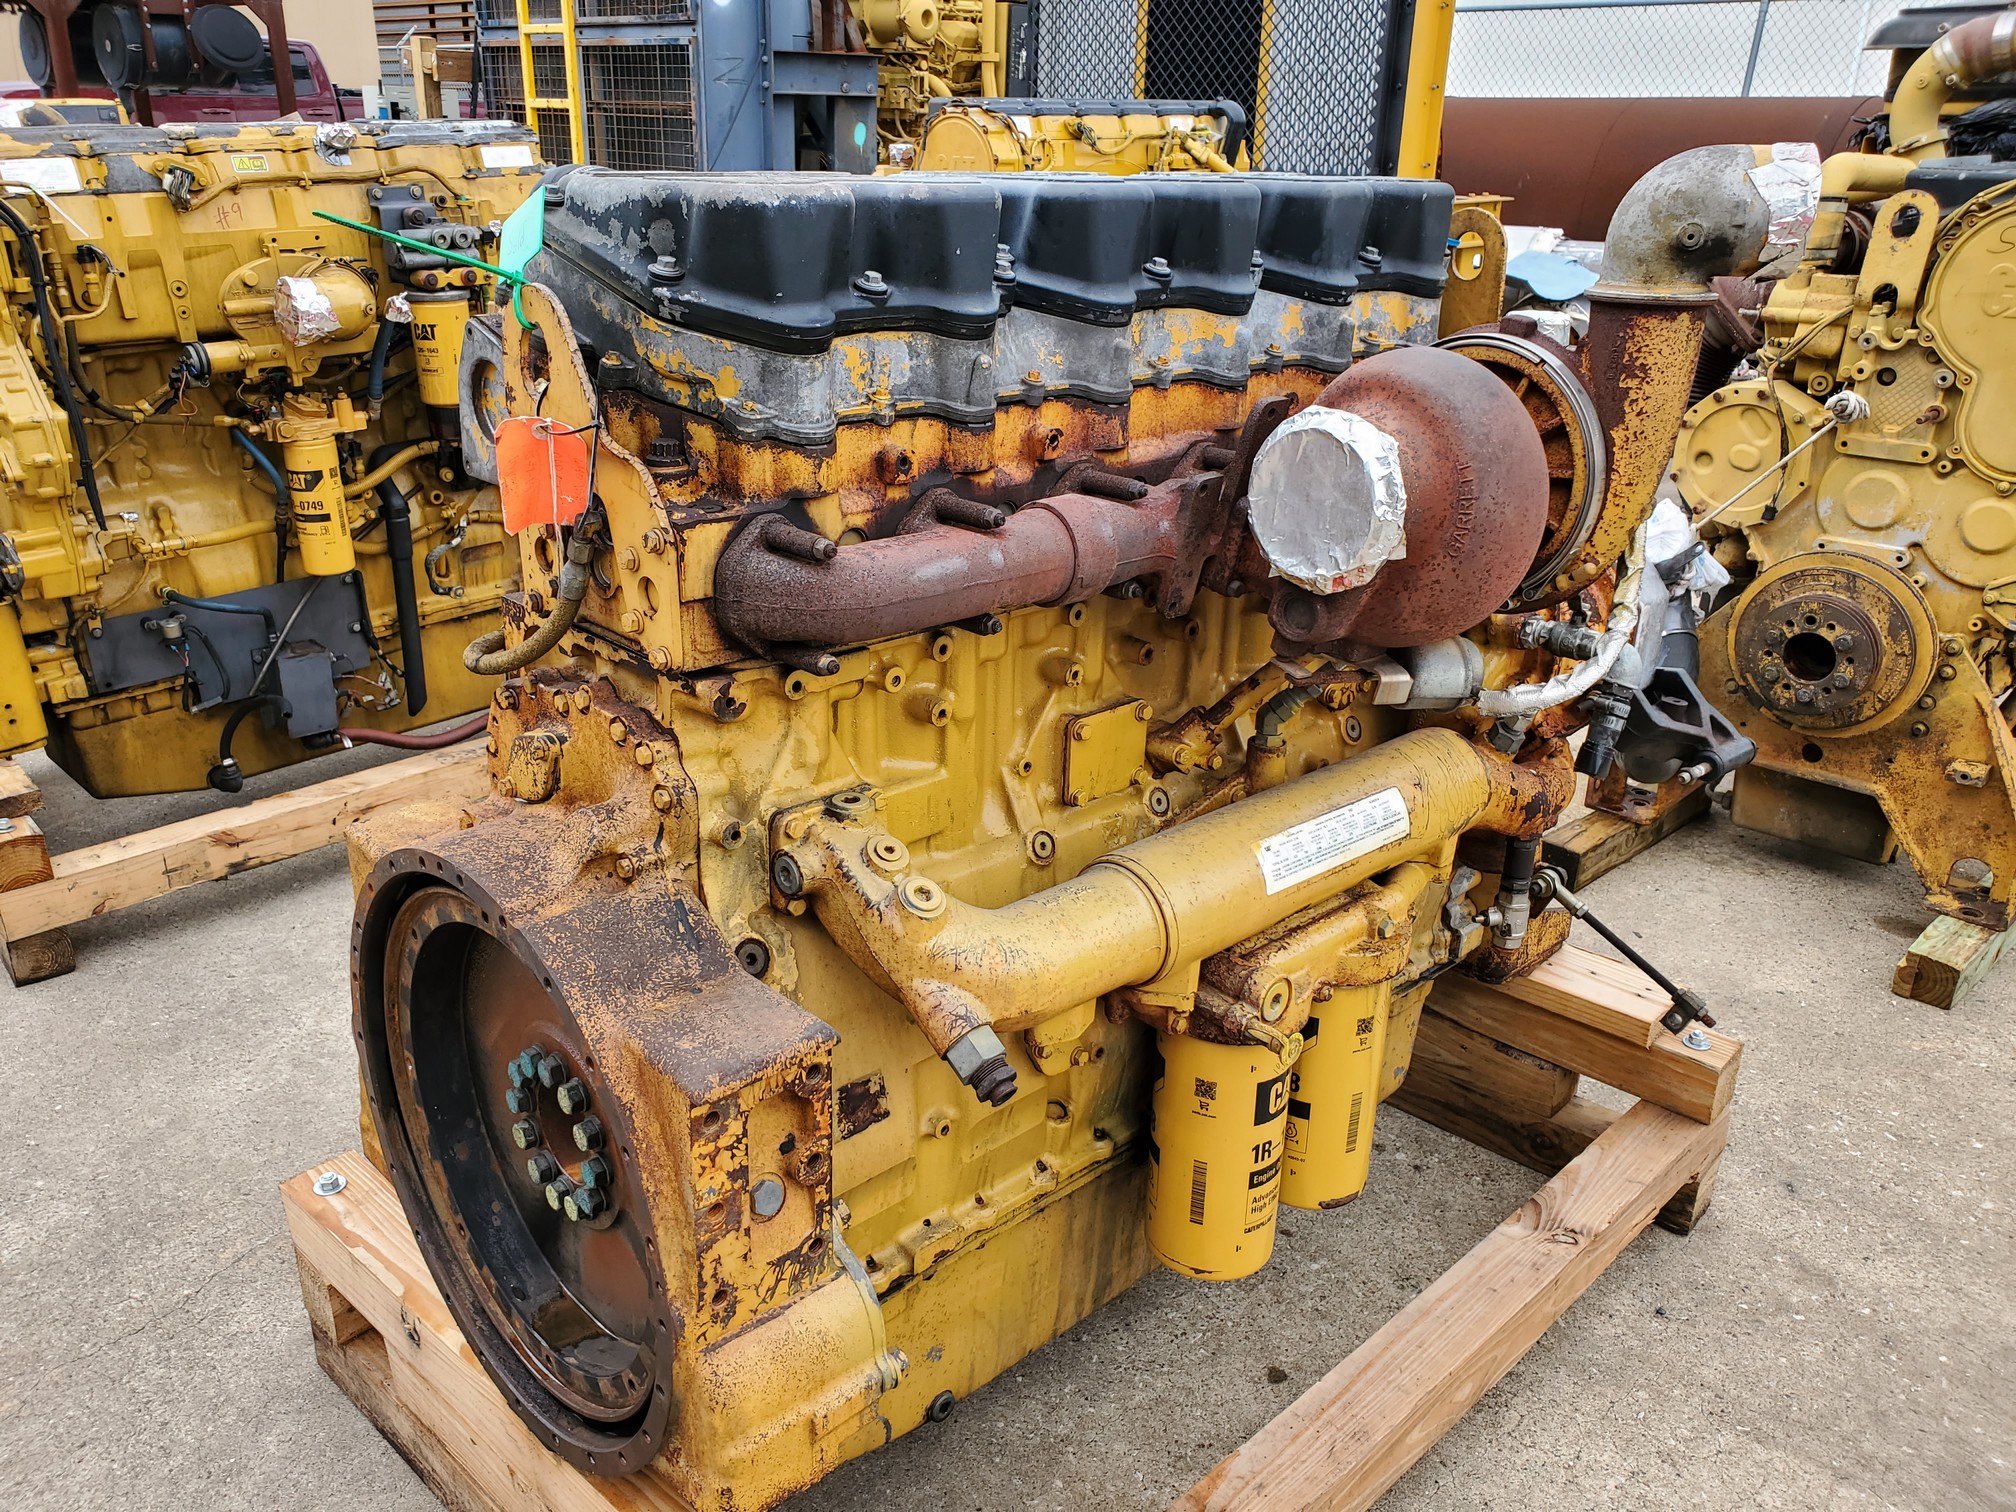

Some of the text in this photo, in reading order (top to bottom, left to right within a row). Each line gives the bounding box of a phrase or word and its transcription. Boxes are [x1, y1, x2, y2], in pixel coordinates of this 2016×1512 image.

[215, 202, 243, 230] #9
[413, 323, 437, 341] CAT
[295, 500, 324, 511] -0749
[1447, 462, 1476, 558] GARRETT
[1268, 1074, 1291, 1115] CA
[1253, 1166, 1276, 1184] Engine
[1250, 1201, 1267, 1214] High
